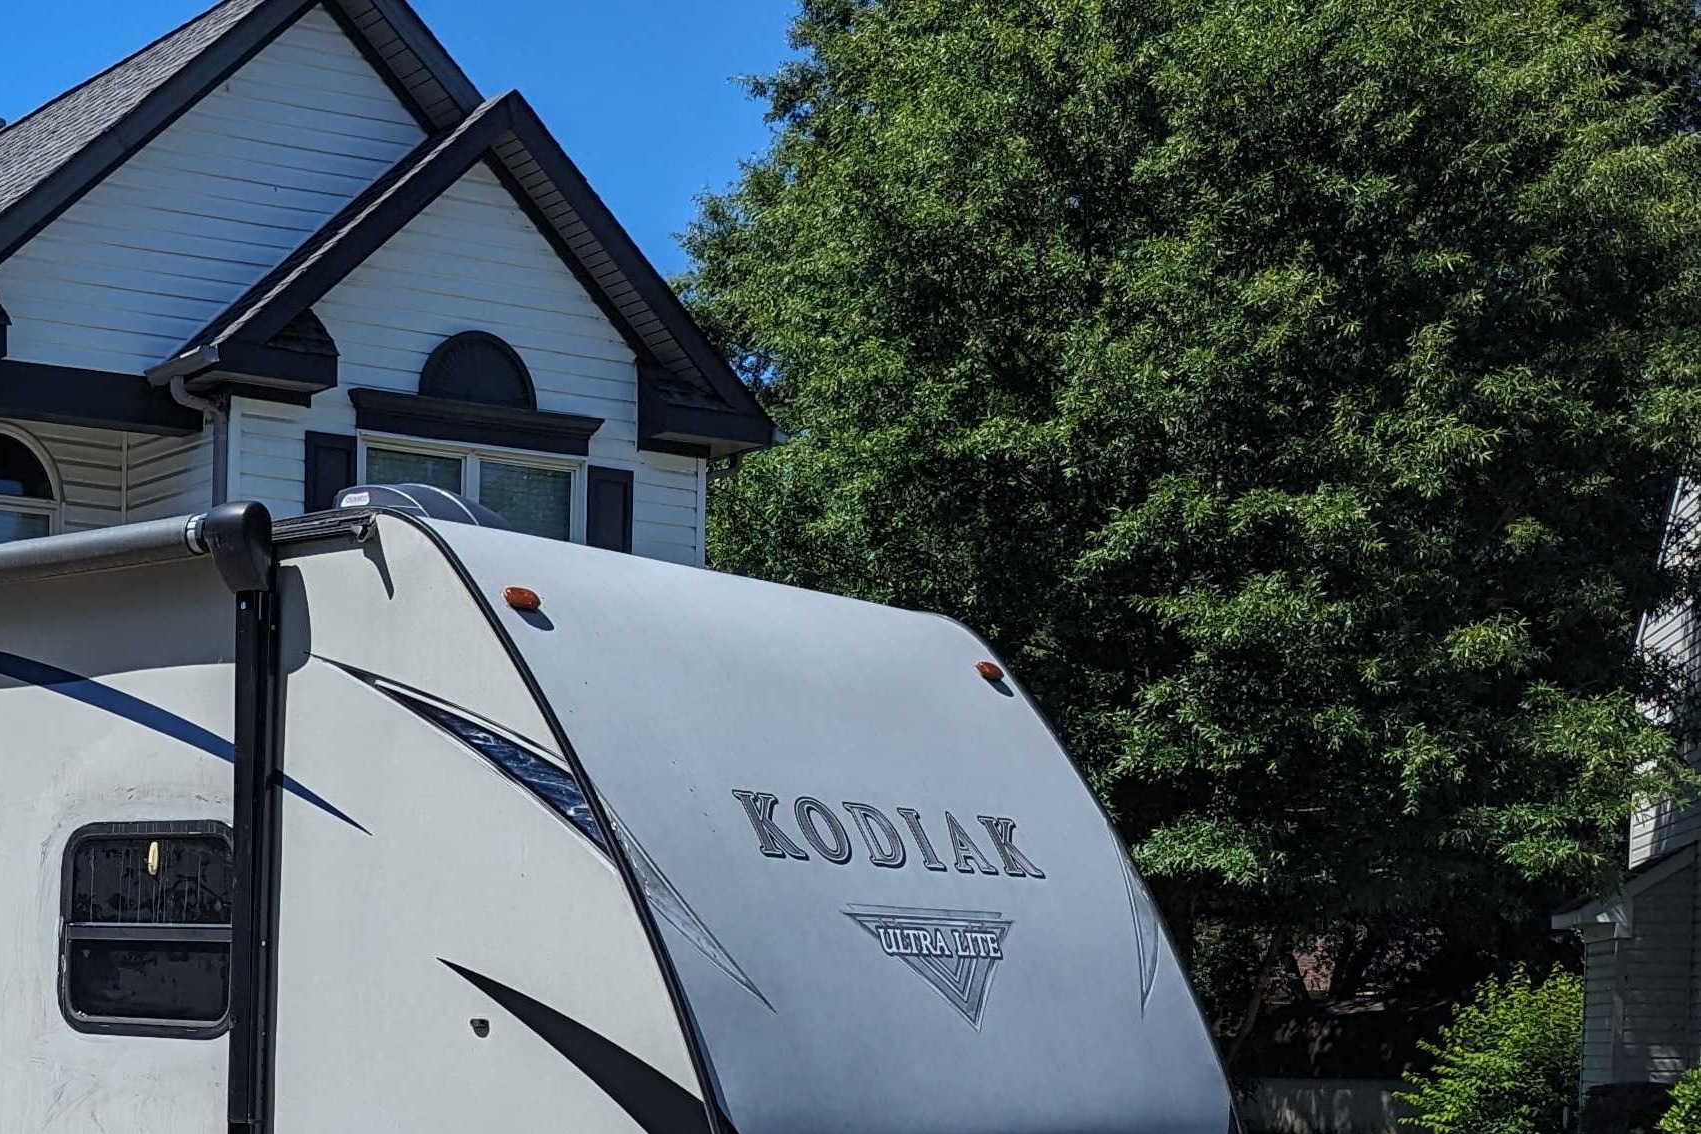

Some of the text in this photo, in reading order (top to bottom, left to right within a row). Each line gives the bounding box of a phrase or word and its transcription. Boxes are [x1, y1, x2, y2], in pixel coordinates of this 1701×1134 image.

[732, 789, 1046, 879] KODIAK
[876, 926, 1003, 960] ULTRA LITE
